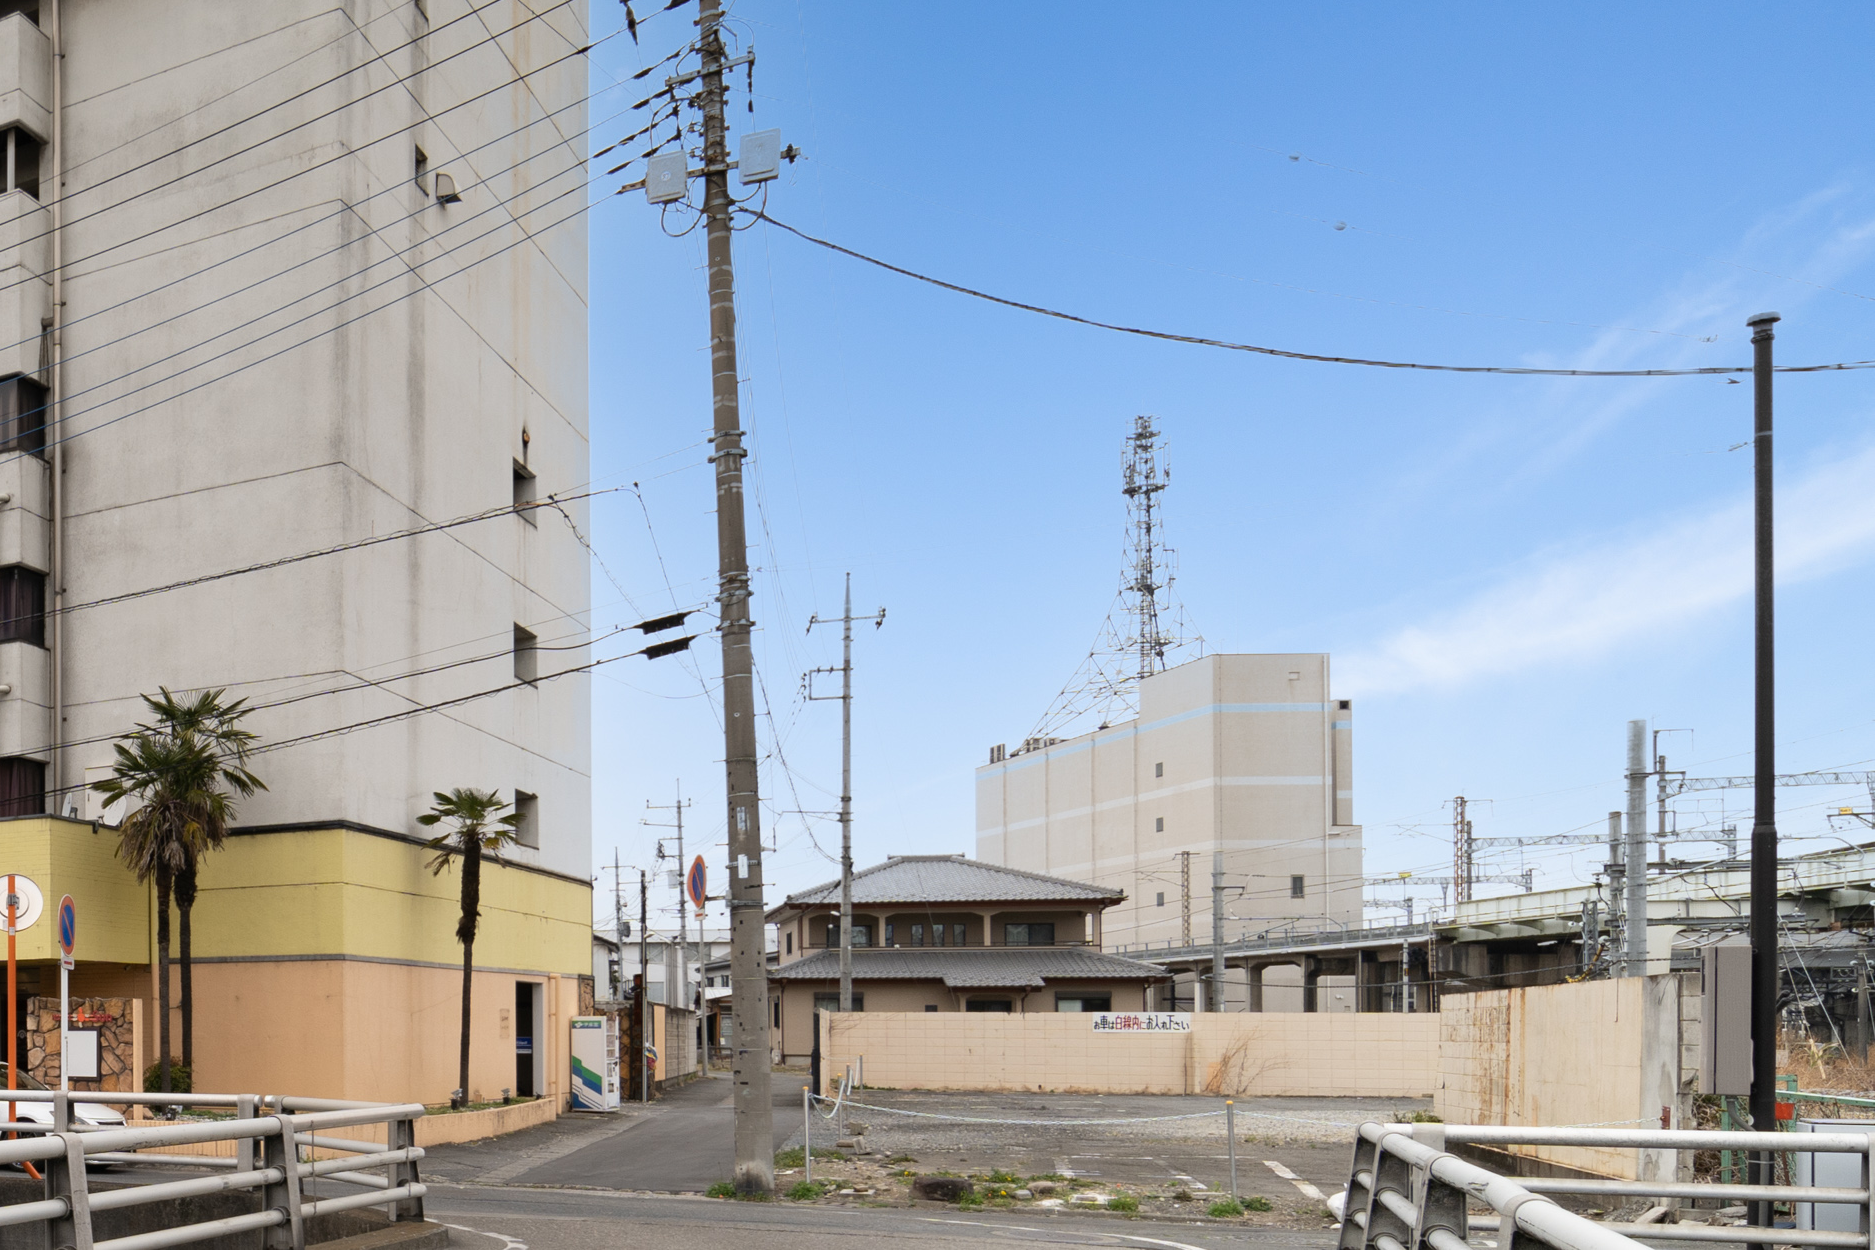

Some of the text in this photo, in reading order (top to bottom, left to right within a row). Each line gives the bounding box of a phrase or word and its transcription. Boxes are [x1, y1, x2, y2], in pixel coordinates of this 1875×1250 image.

[1093, 1015, 1190, 1030] お車は白線内にお入れ下さい
